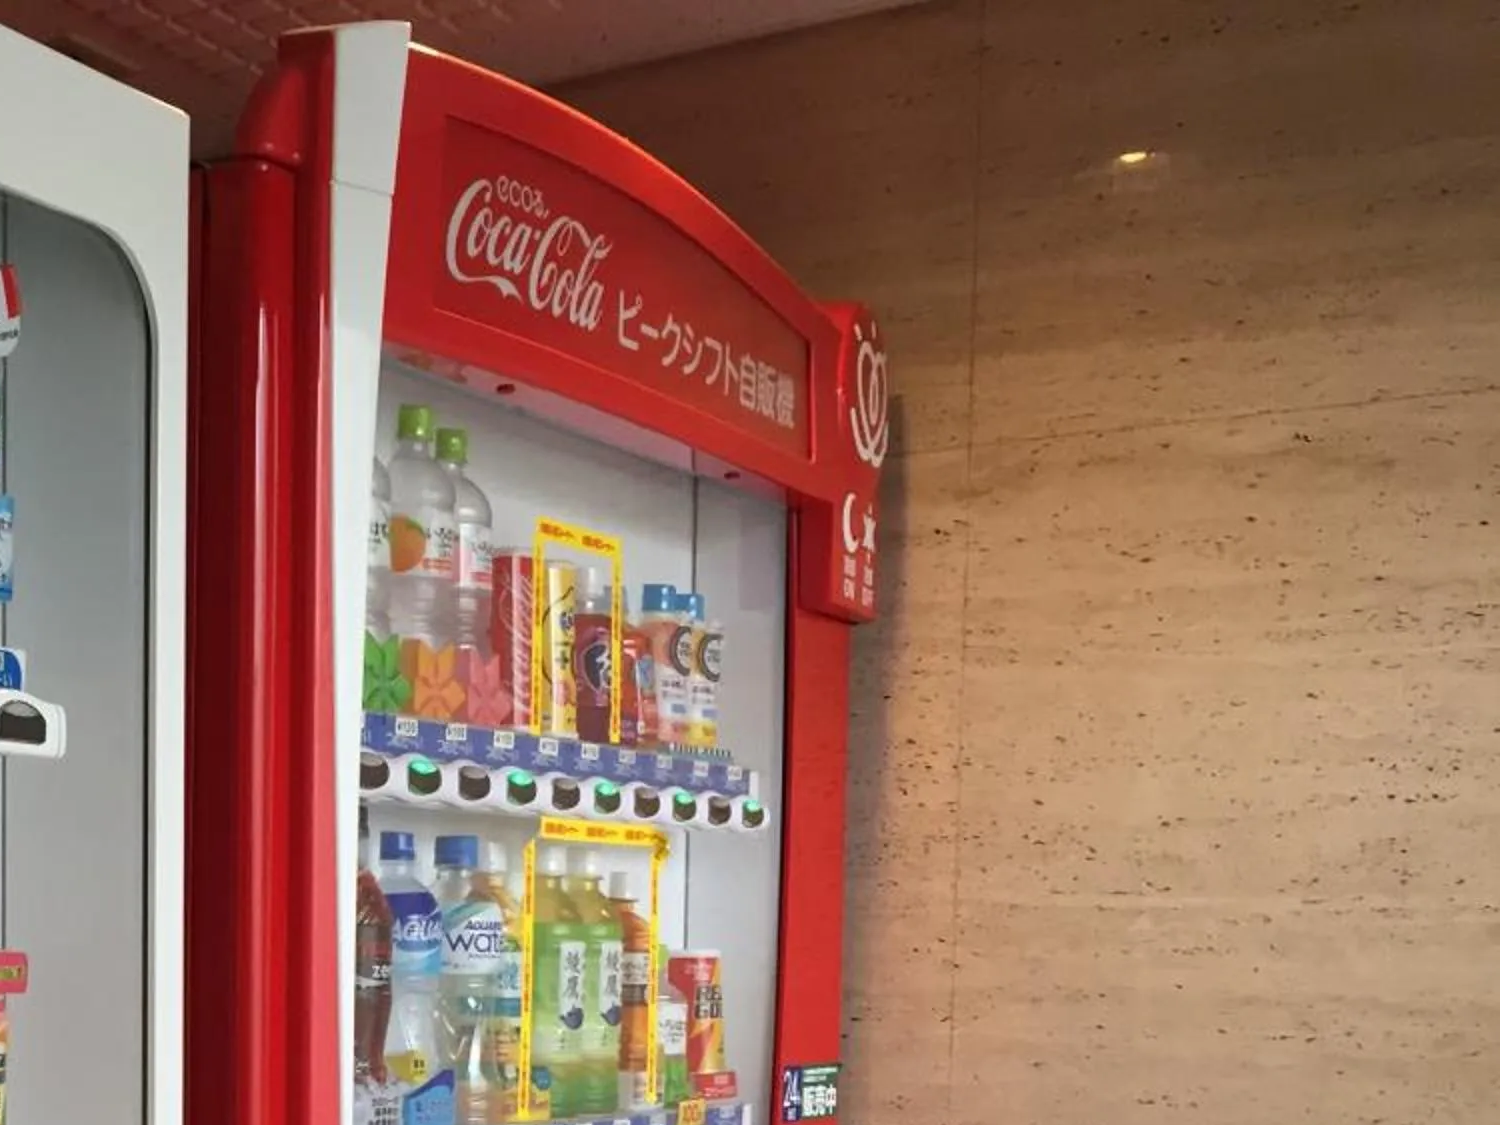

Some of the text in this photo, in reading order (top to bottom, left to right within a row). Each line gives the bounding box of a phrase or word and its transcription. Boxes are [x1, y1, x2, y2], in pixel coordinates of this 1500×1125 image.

[445, 178, 614, 332] Coca-Cola
[616, 289, 797, 430] ピークシフト自販機
